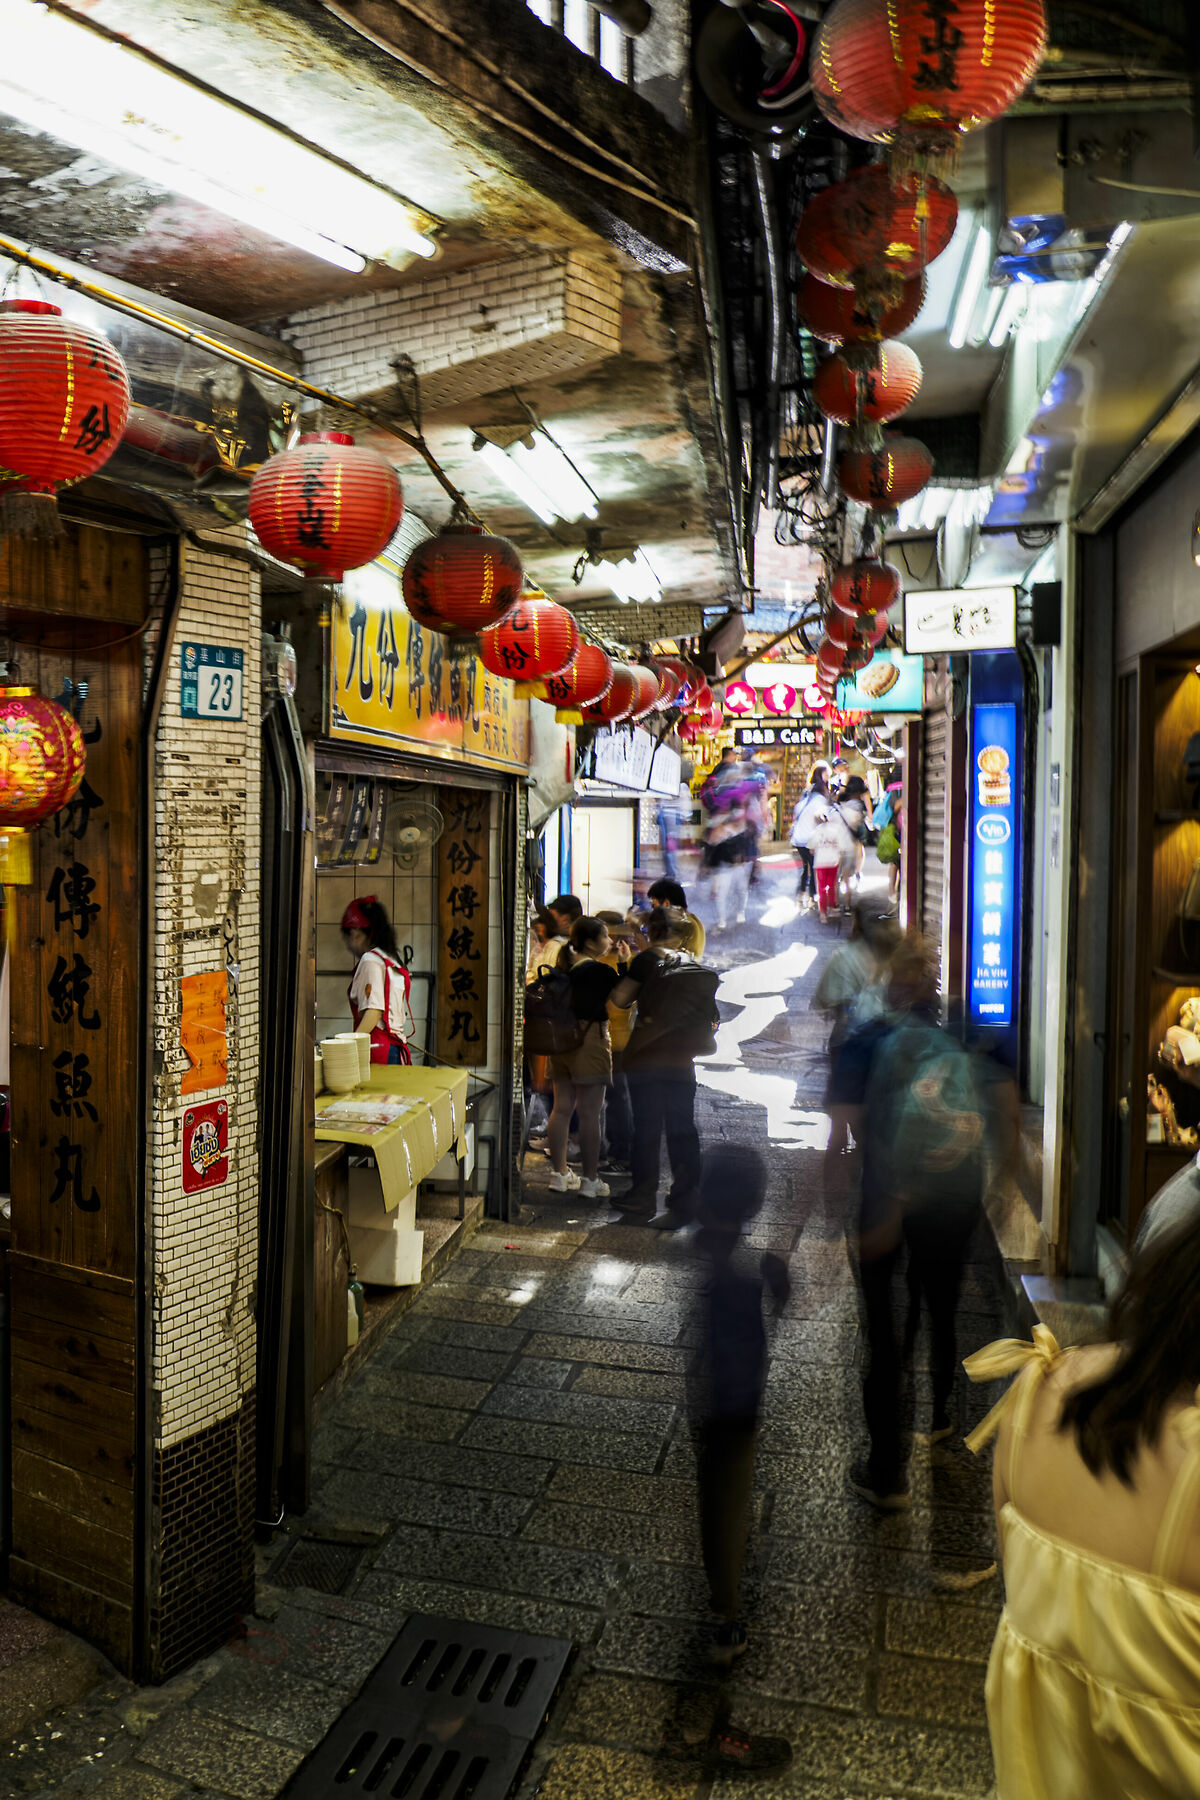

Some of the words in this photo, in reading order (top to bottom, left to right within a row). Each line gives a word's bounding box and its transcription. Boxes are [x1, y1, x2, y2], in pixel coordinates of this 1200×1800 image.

[73, 337, 120, 455] 九份
[501, 608, 531, 671] 九份
[208, 673, 233, 711] 23
[742, 729, 775, 744] B&B
[780, 728, 815, 744] Cafe
[446, 802, 482, 1042] 九份傳統魚丸
